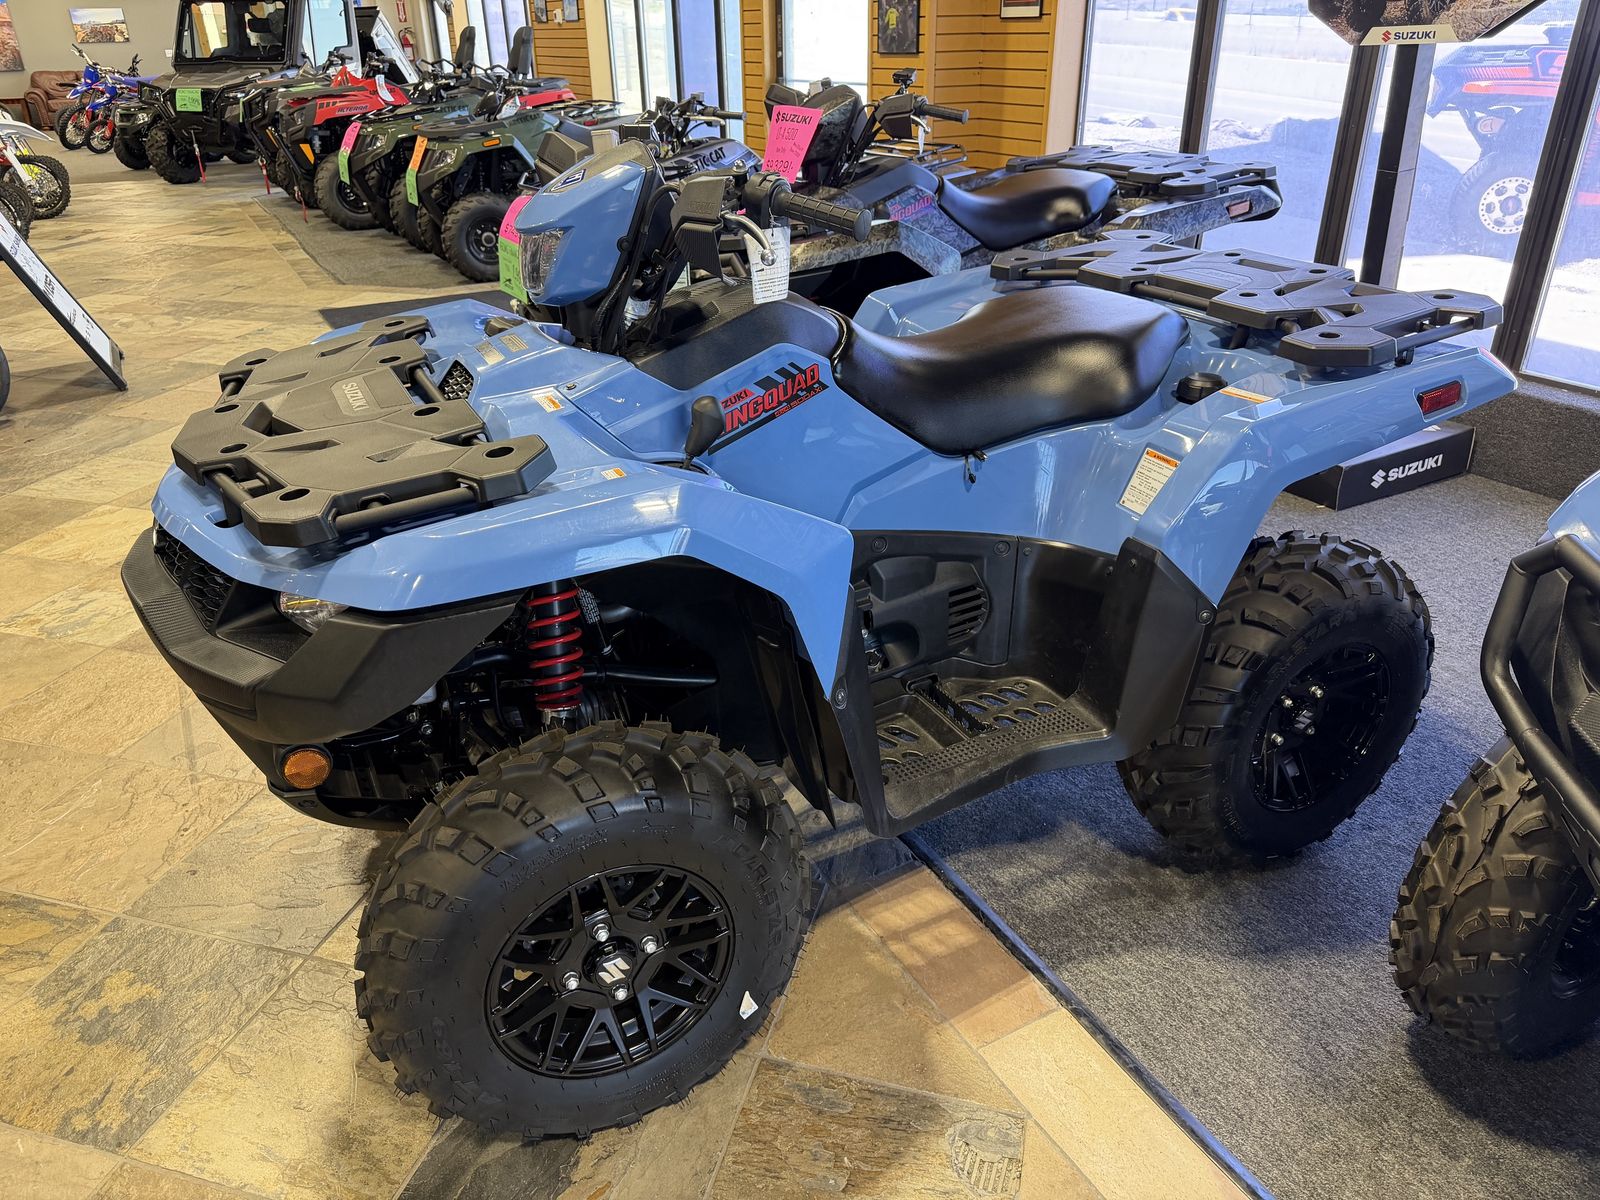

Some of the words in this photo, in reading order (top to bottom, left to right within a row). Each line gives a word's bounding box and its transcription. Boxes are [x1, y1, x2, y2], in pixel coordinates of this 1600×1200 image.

[1394, 30, 1436, 40] SUZUKI
[781, 112, 813, 125] SUZUKI
[709, 146, 727, 164] CAT
[342, 382, 370, 411] SUZUKI
[721, 390, 749, 409] ZUKI
[724, 363, 820, 433] INGQUAD
[1387, 454, 1443, 481] SUZUKI
